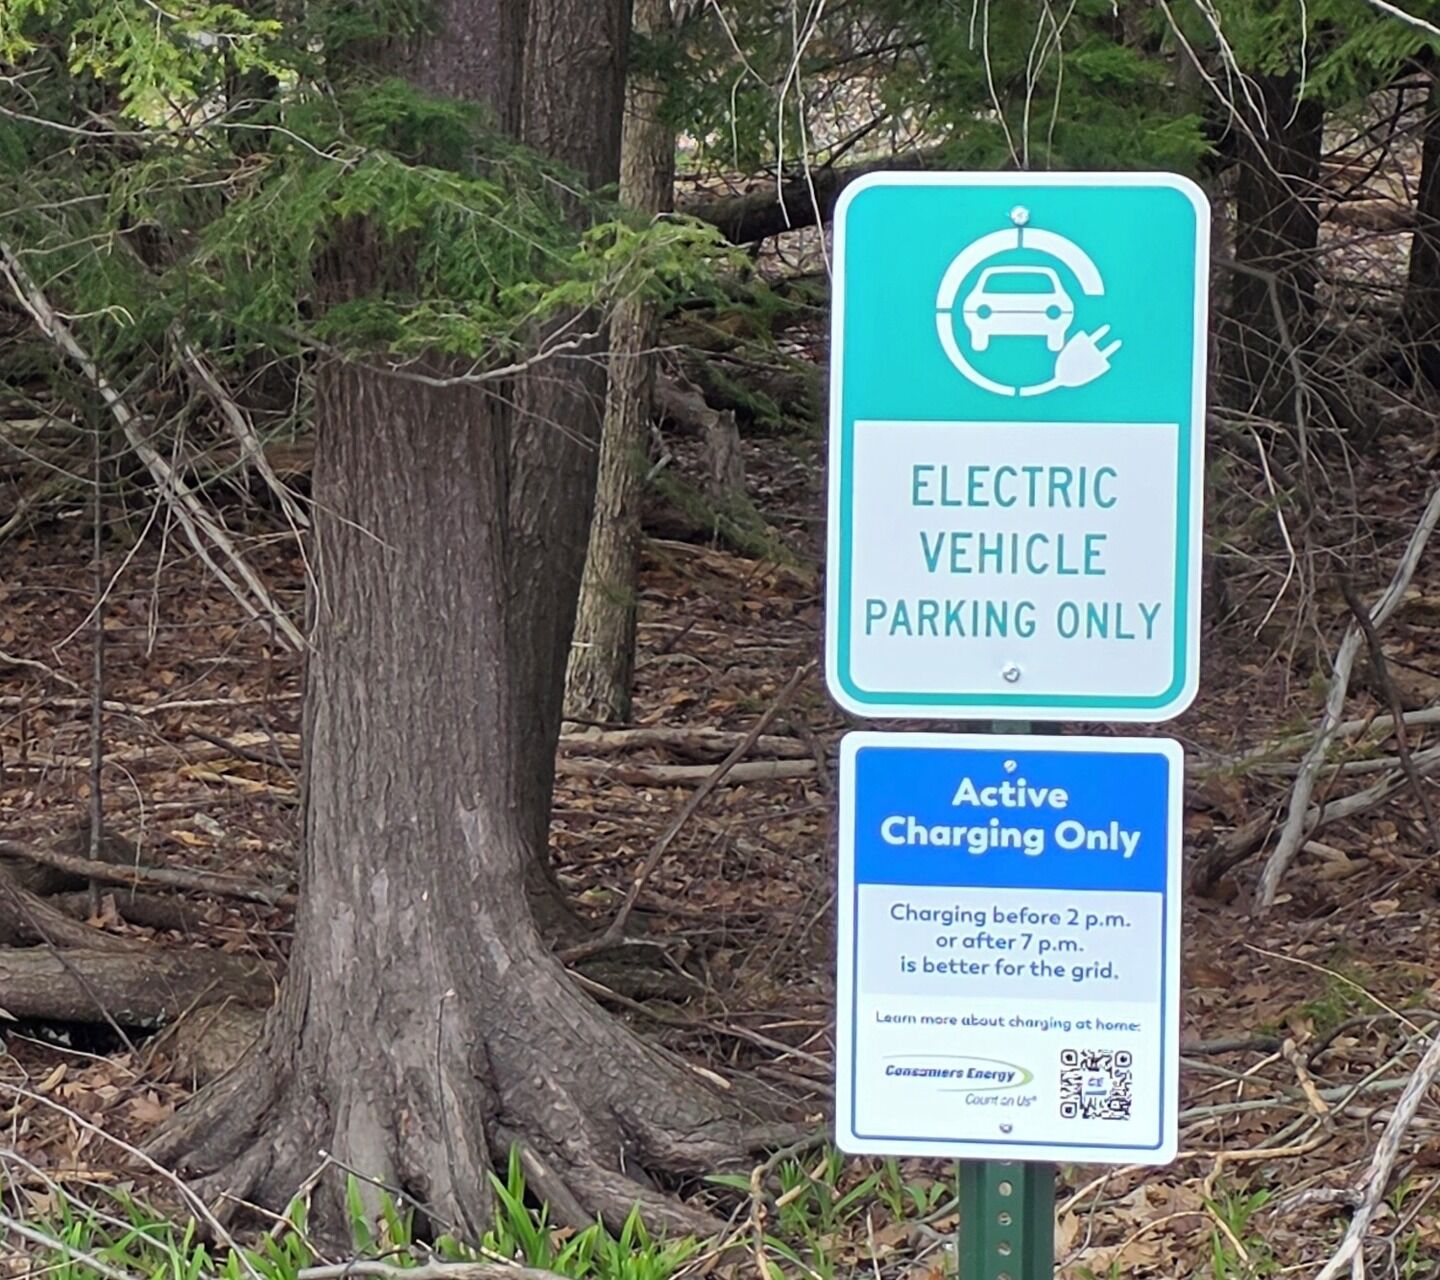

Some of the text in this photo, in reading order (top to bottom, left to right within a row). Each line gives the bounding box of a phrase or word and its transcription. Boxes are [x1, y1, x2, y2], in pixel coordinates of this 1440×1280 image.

[912, 465, 1118, 508] ELECTRIC
[920, 532, 1107, 575] VEHICLE
[865, 599, 1162, 640] PARKING ONLY
[952, 777, 1068, 808] Active
[881, 815, 1141, 858] Charging Only
[890, 903, 1131, 930] Charging before 2 p.m.
[936, 931, 1084, 954] or after 7 p.m.
[900, 956, 1119, 982] is better for the grid.
[876, 1010, 916, 1024] Learn
[920, 1015, 957, 1025] more
[961, 1013, 1005, 1027] about
[1008, 1015, 1071, 1032] charging
[1076, 1019, 1092, 1029] at
[966, 1067, 1016, 1083] Energy
